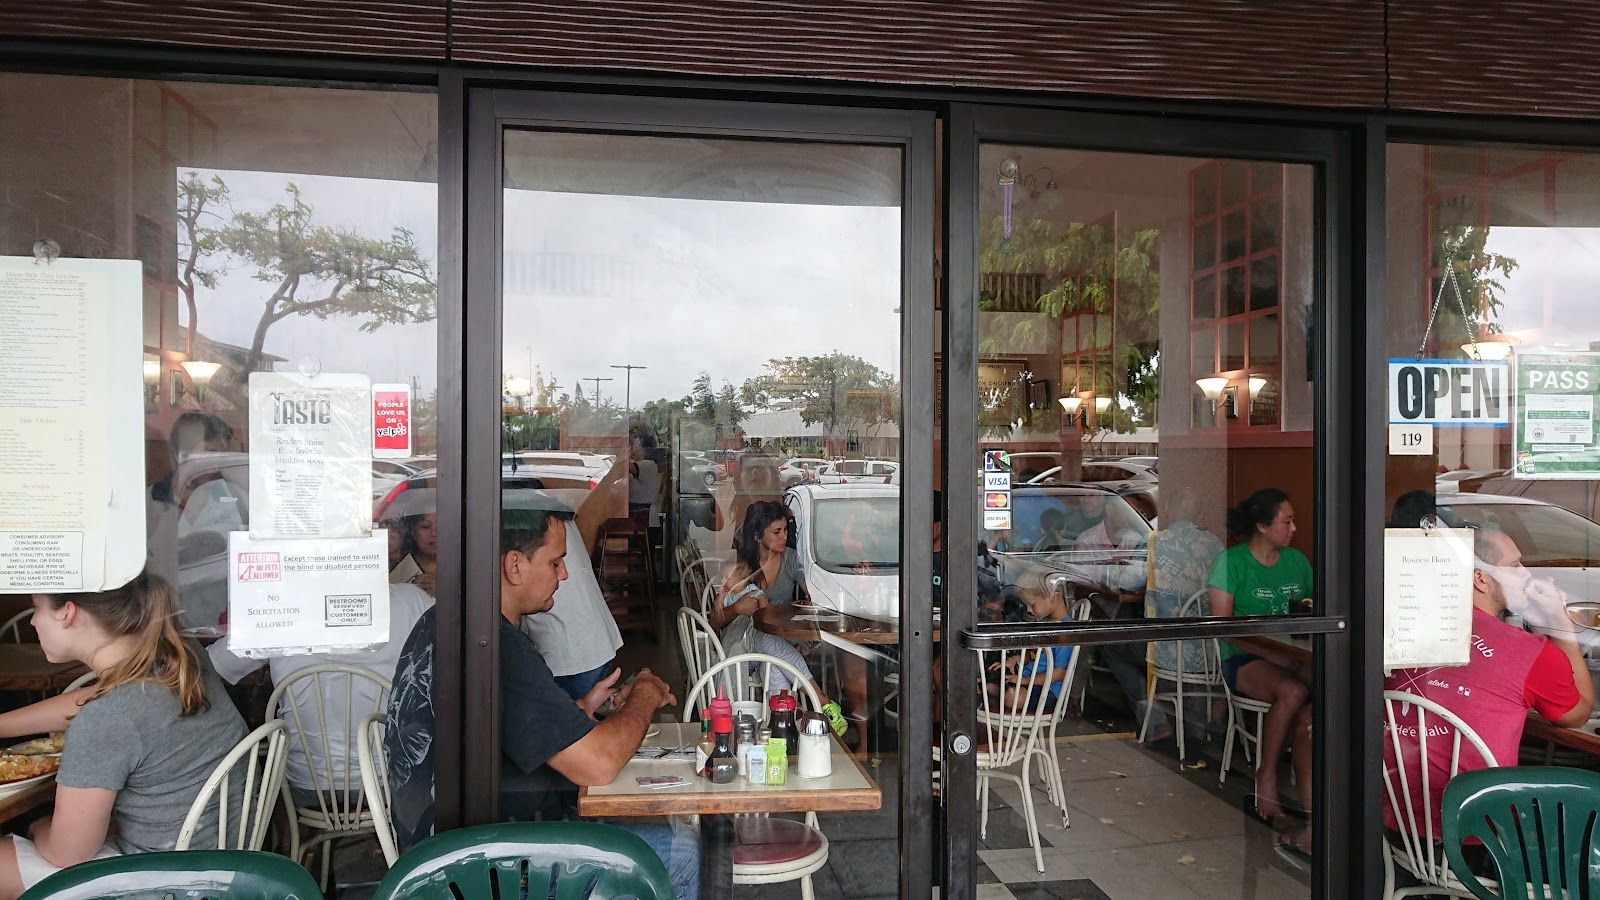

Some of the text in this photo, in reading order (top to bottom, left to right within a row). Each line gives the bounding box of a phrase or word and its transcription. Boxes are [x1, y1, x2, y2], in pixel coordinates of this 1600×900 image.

[1529, 370, 1589, 389] PASS
[1398, 366, 1499, 419] OPEN
[377, 427, 397, 437] yelp
[1401, 433, 1422, 446] 119
[988, 477, 1008, 486] VISA
[354, 562, 380, 570] persons
[253, 571, 279, 579] ALLOWED
[248, 608, 300, 616] SOLICITATION
[1427, 680, 1449, 689] aloha
[1424, 724, 1449, 737] alu
